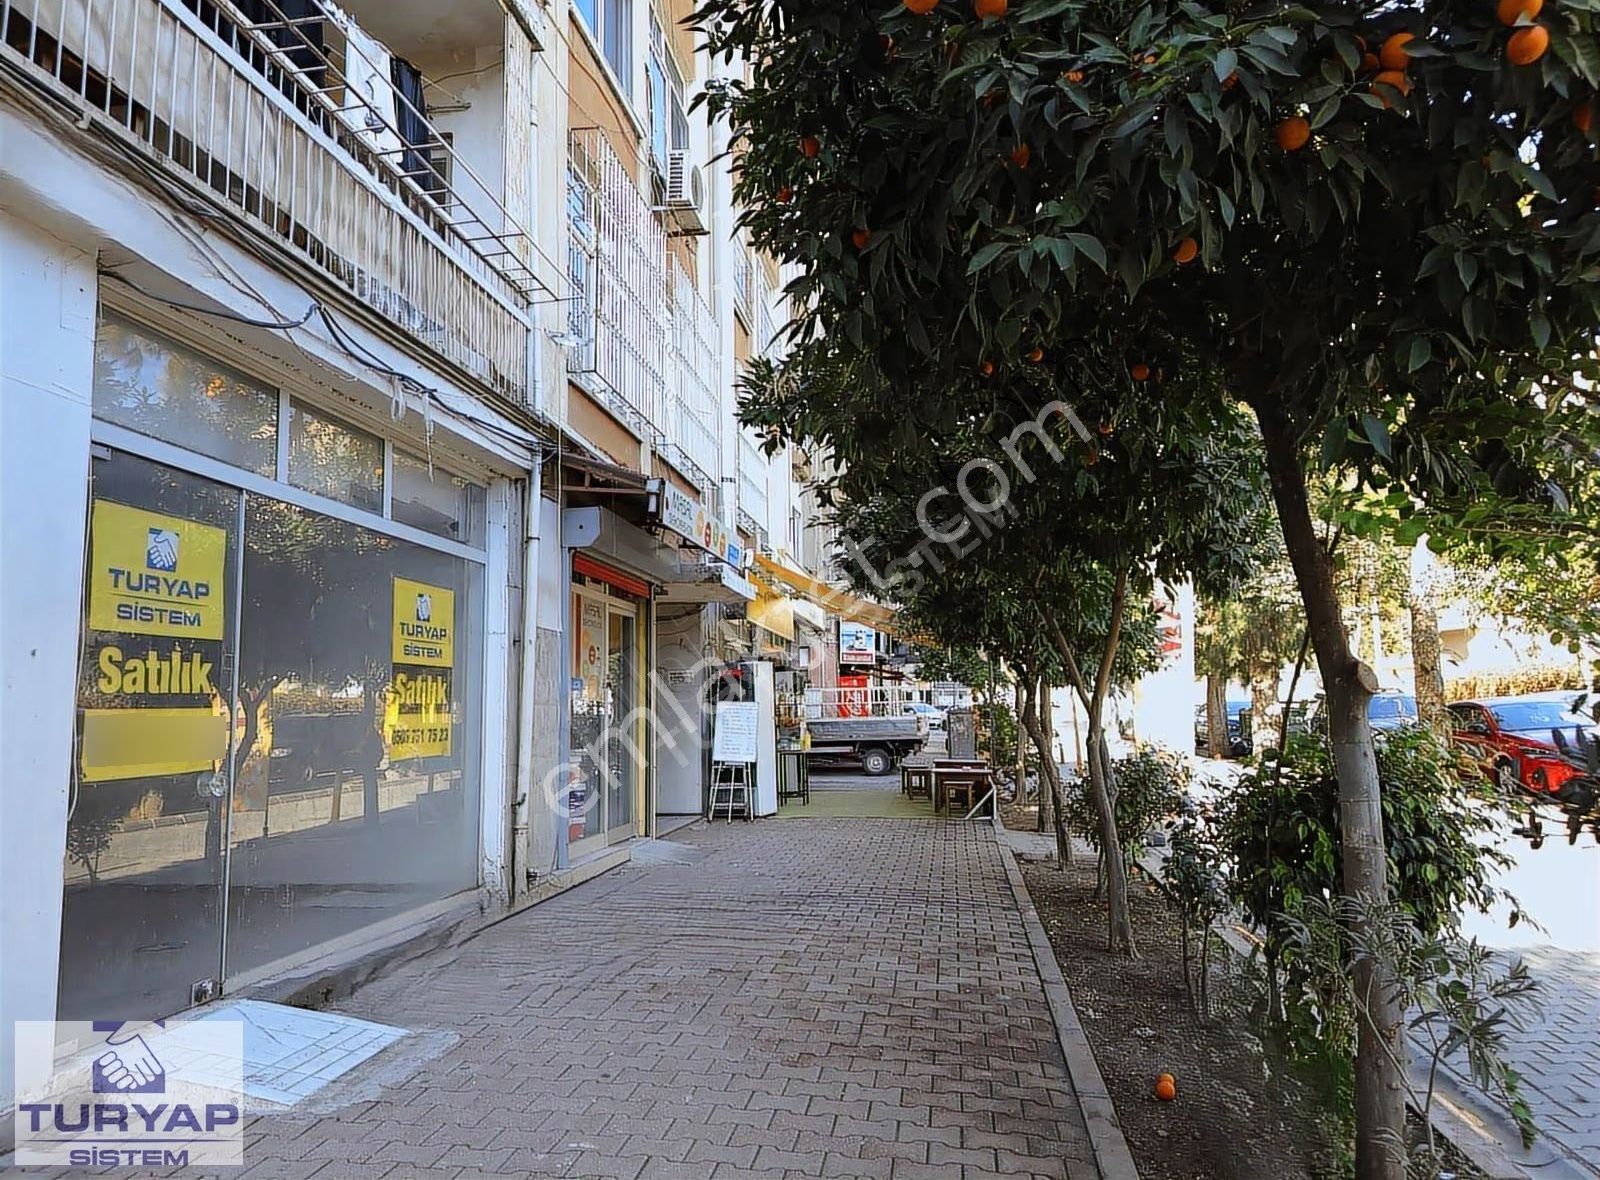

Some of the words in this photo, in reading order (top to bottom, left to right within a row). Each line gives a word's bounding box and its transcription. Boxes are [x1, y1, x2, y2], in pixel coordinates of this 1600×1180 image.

[108, 568, 211, 600] TURYAP
[116, 603, 202, 628] SİSTEM
[399, 620, 448, 641] TURYAP
[403, 643, 443, 659] SİSTEM
[98, 645, 215, 696] Satılık
[395, 671, 448, 704] Satılık
